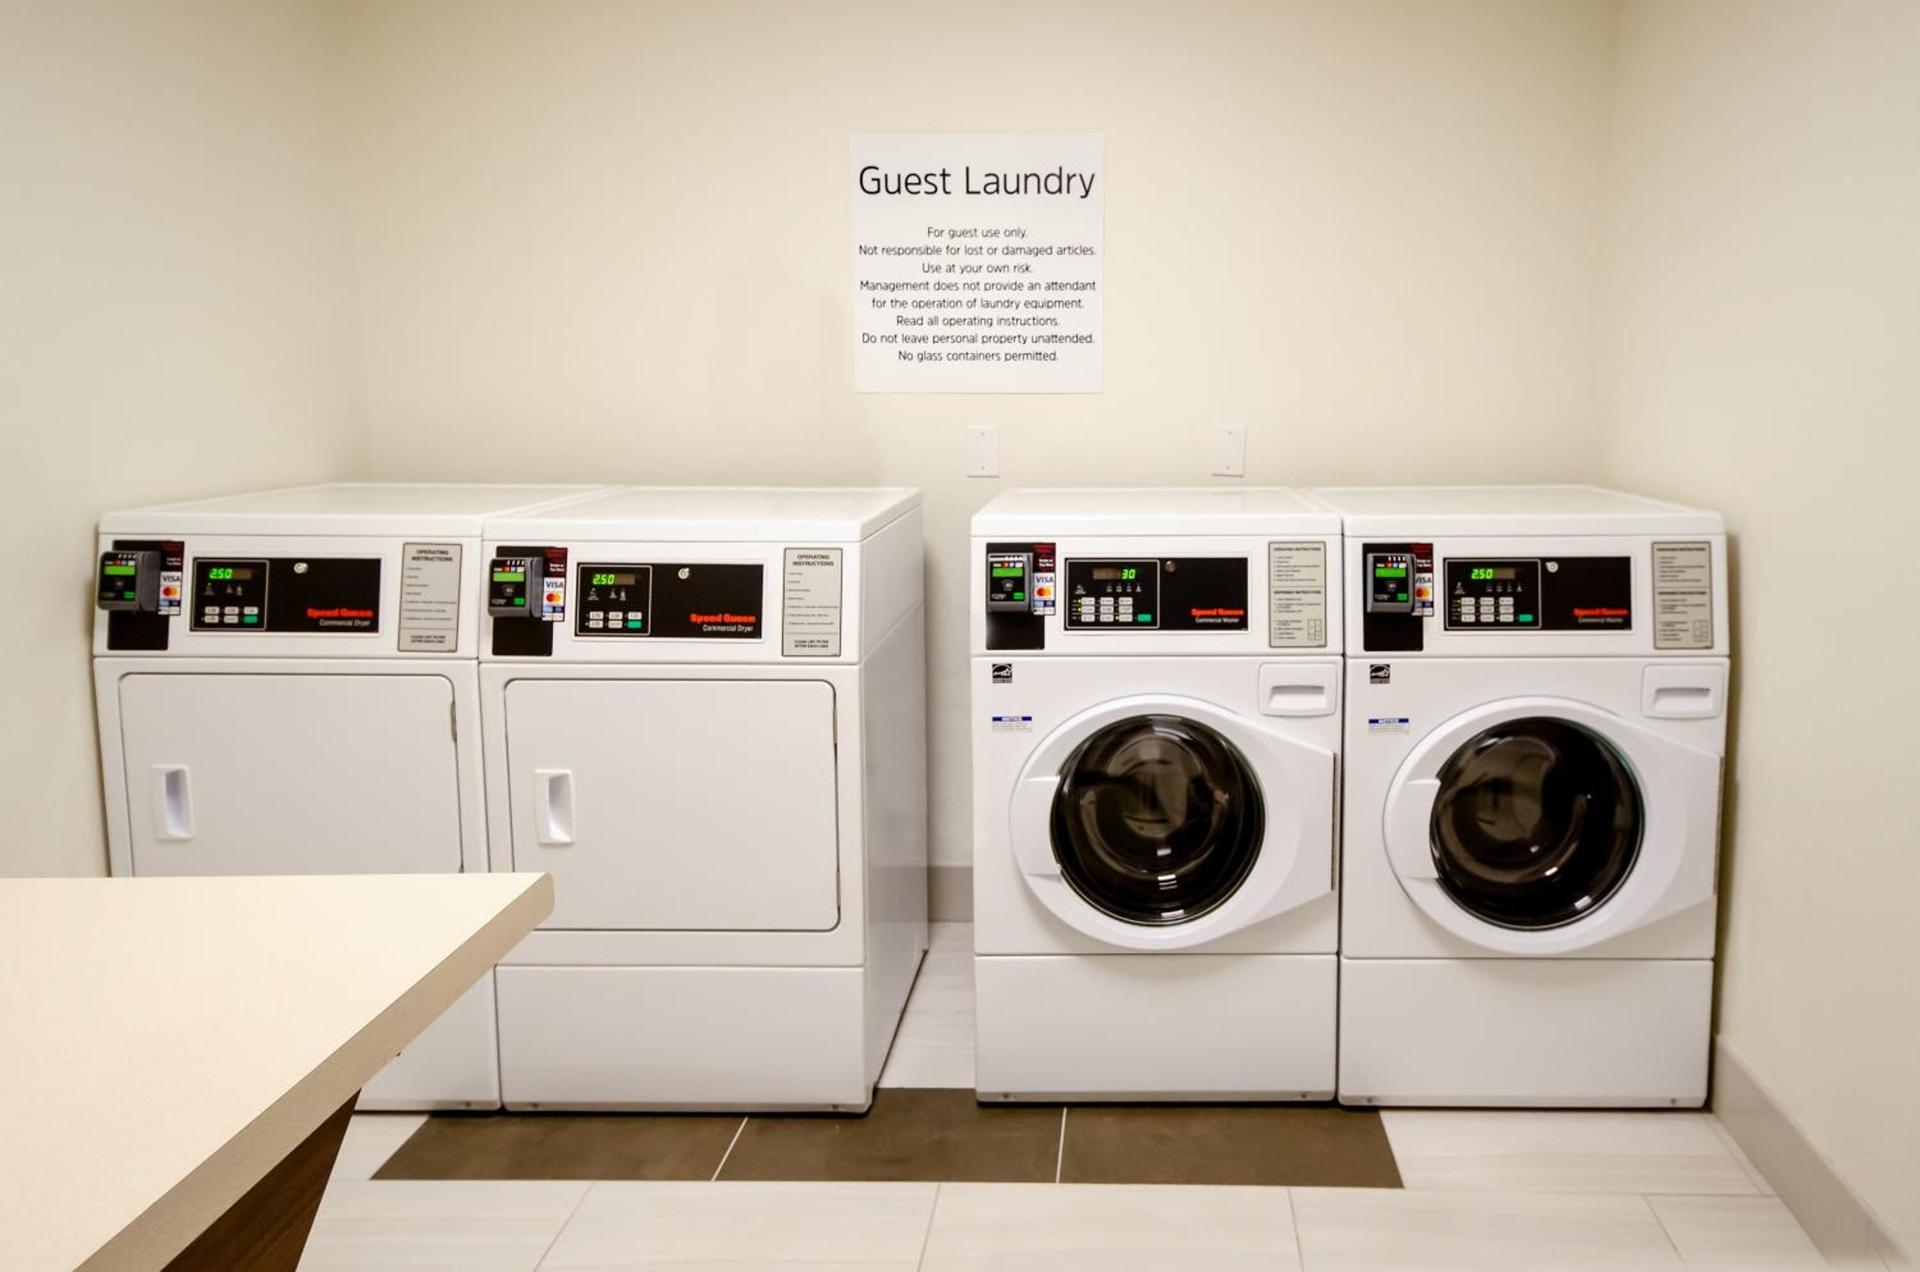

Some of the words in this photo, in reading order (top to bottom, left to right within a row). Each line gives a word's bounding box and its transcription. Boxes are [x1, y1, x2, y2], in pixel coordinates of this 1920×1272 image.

[859, 166, 951, 195] Guest
[966, 166, 1096, 199] Laundry
[927, 226, 945, 238] For
[948, 228, 978, 239] guest
[981, 229, 1000, 238] use
[1004, 227, 1028, 239] only.
[859, 244, 879, 256] Not
[881, 244, 942, 256] responsible
[946, 244, 961, 255] for
[964, 245, 983, 255] lost
[986, 247, 998, 255] or
[1002, 245, 1053, 257] damaged
[1056, 245, 1096, 256] articles.
[922, 262, 942, 274] Use
[945, 264, 956, 273] at
[960, 264, 983, 274] your
[986, 264, 1010, 273] own
[1013, 263, 1033, 273] risk.
[860, 280, 930, 292] Management
[933, 280, 960, 291] does
[963, 280, 981, 291] not
[984, 280, 1024, 292] provide
[1027, 282, 1041, 291] an
[1044, 280, 1096, 291] attendant
[872, 298, 887, 309] for
[890, 298, 908, 309] the
[911, 296, 963, 310] operation
[966, 298, 977, 309] of
[980, 298, 1021, 310] laundry
[1023, 298, 1084, 310] equipment.
[896, 315, 924, 326] Read
[927, 315, 939, 326] all
[942, 315, 994, 328] operating
[997, 316, 1060, 326] instructions.
[862, 332, 877, 344] Do
[880, 334, 898, 344] not
[901, 333, 929, 344] leave
[932, 333, 978, 344] personal
[981, 334, 1028, 345] property
[1031, 333, 1095, 344] unattended.
[898, 350, 913, 361] No
[917, 350, 943, 363] glass
[946, 351, 1001, 361] containers
[1004, 350, 1058, 362] permitted.
[1122, 568, 1136, 580] 30
[307, 608, 338, 619] Speed
[340, 608, 374, 618] Queen
[690, 613, 722, 624] Speed
[724, 614, 756, 623] Queen
[1191, 608, 1217, 617] Speed
[702, 624, 736, 632] Commercial
[738, 624, 754, 632] Dryer
